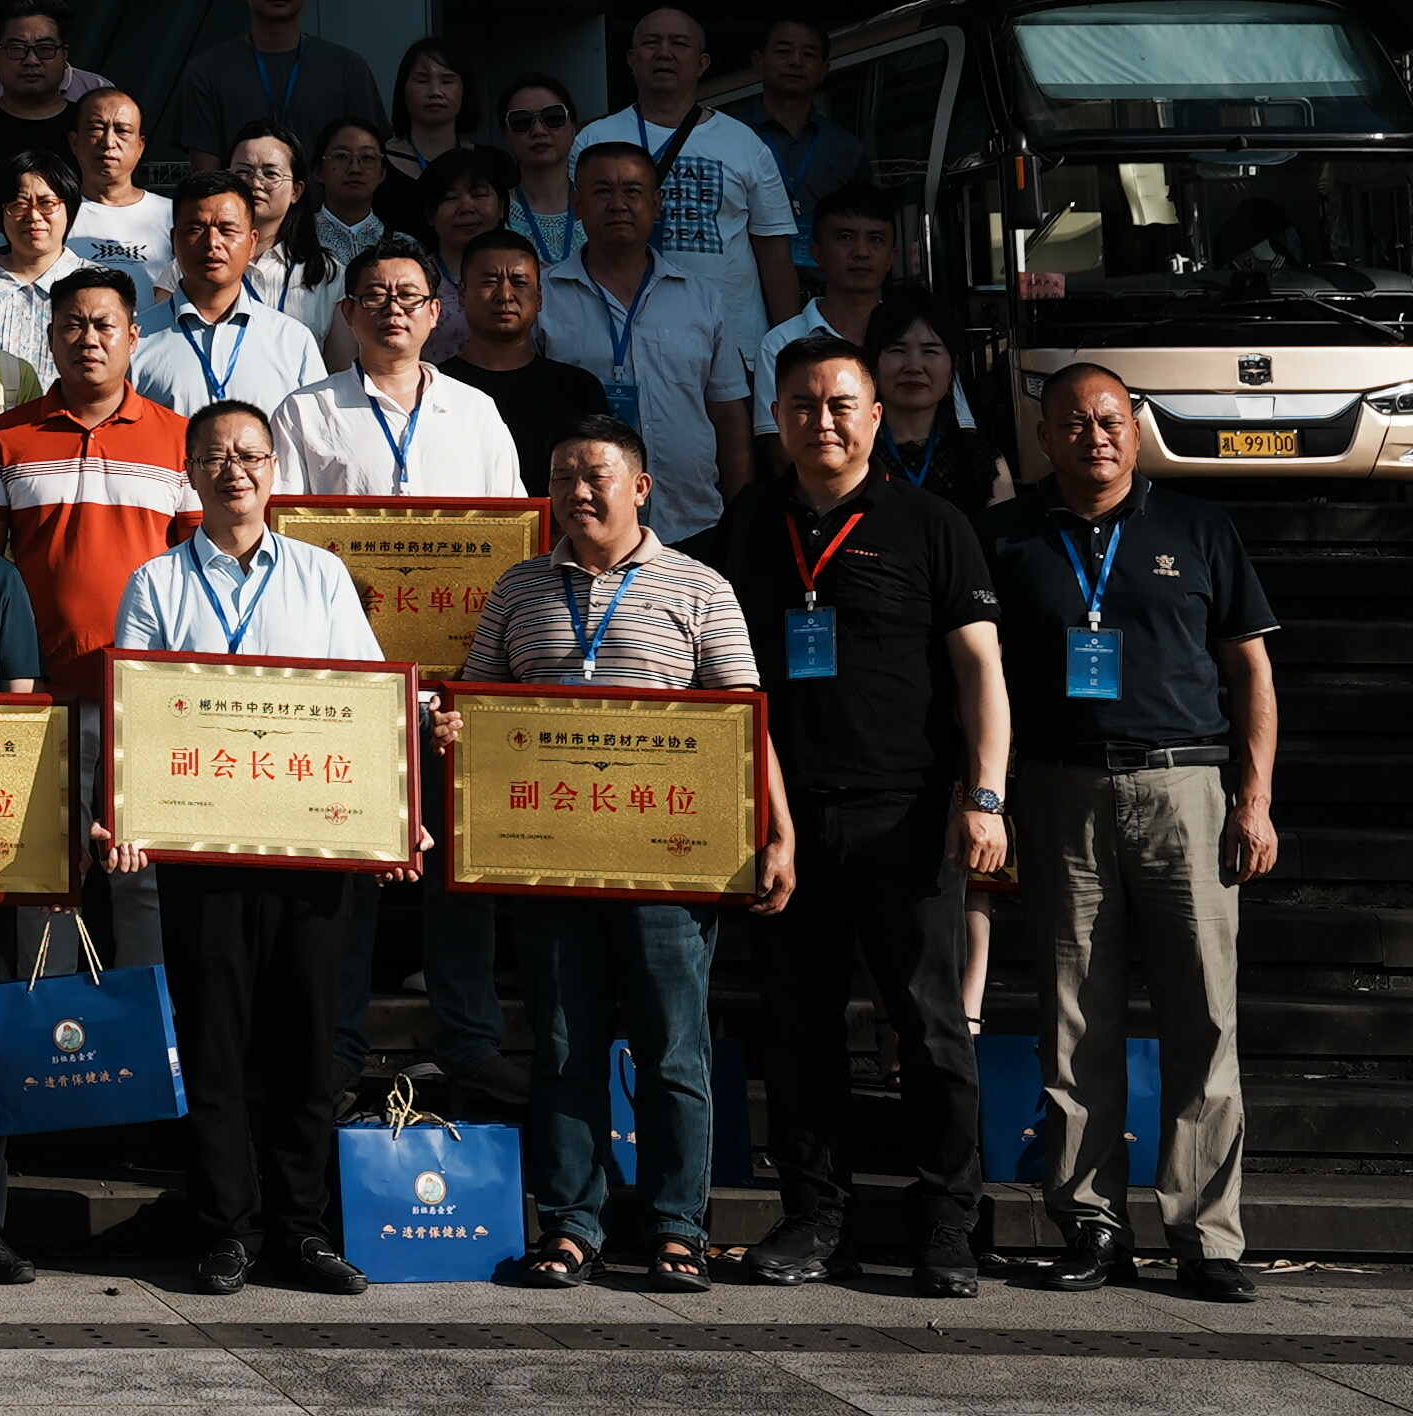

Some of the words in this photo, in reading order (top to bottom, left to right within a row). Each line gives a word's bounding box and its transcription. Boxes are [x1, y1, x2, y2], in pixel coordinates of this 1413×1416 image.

[669, 166, 713, 181] YAL
[660, 227, 708, 242] DEA
[350, 540, 493, 554] 郴州市中药材产业协会
[199, 698, 354, 719] 郴州市中药材产业协会
[539, 731, 698, 750] 郴州市中药材产业协会
[170, 745, 354, 785] 副会长单位
[508, 779, 699, 816] 副会长单位
